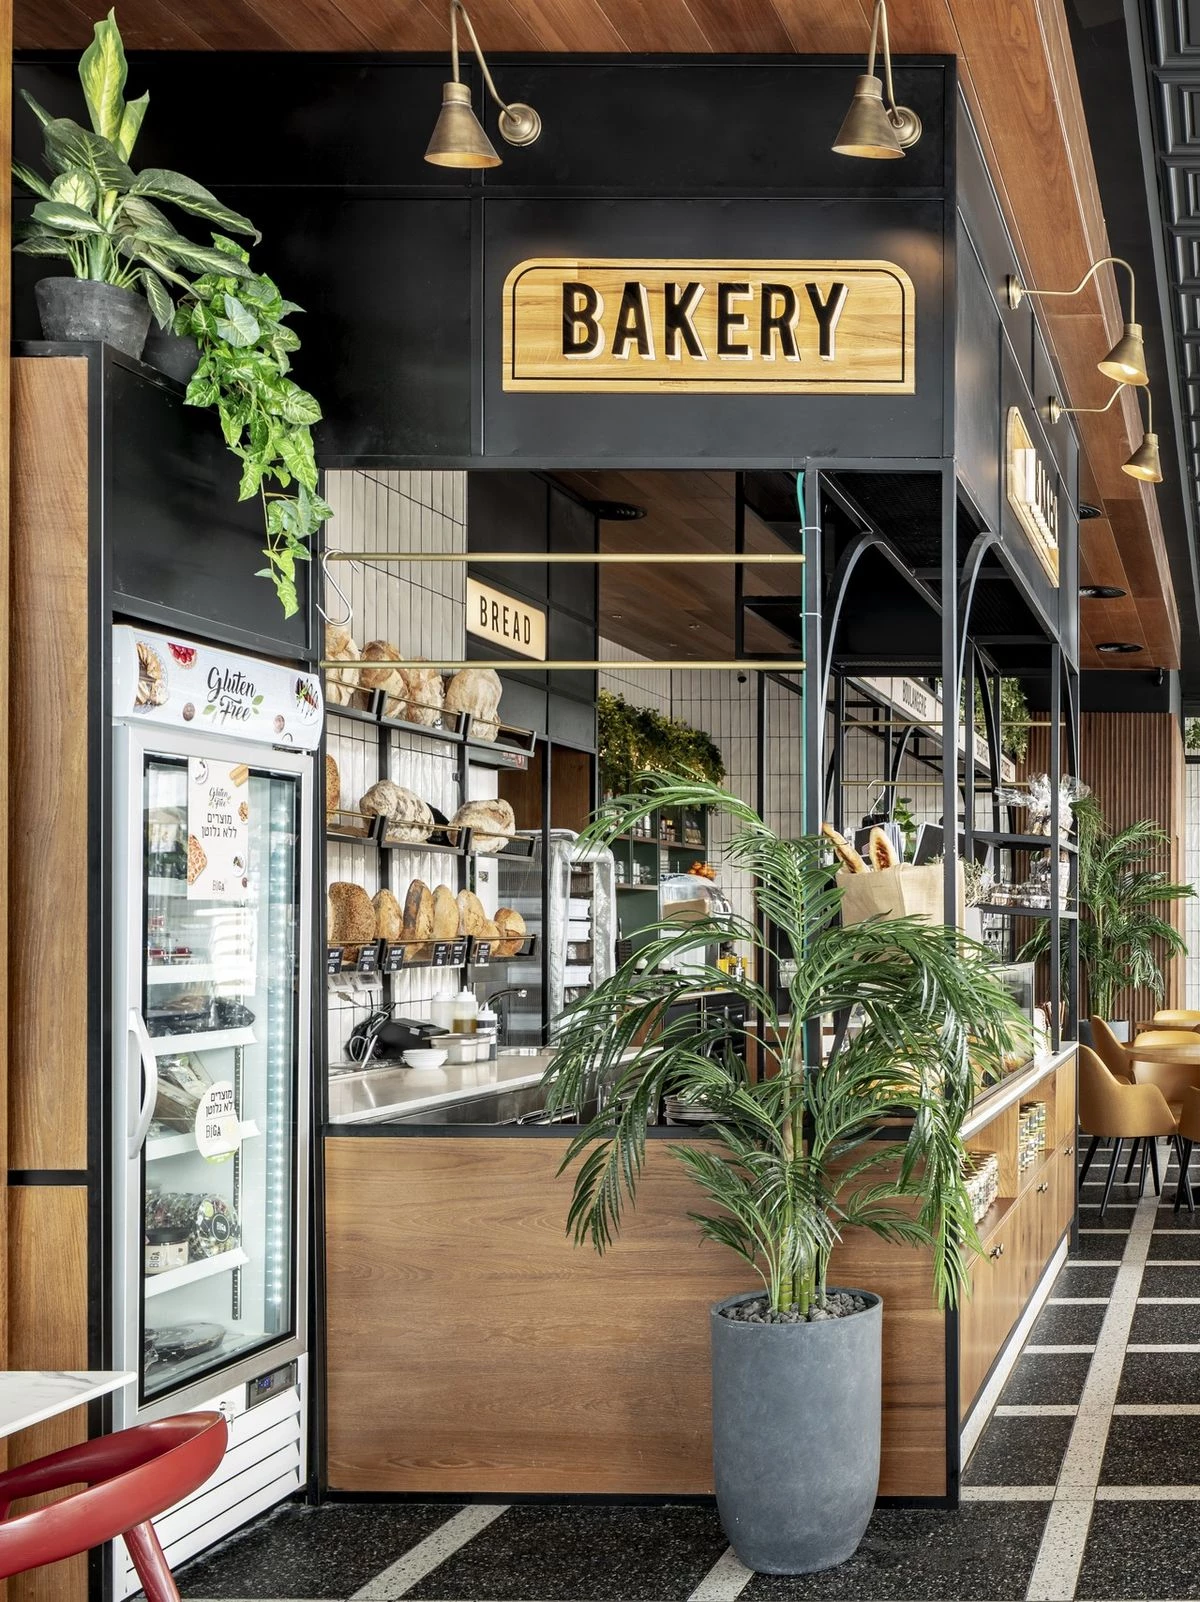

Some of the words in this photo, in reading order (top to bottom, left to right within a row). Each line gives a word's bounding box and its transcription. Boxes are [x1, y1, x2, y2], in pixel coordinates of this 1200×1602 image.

[561, 281, 850, 361] BAKERY
[480, 595, 531, 646] BREAD
[207, 666, 257, 703] Gluten
[219, 695, 251, 725] Free
[207, 813, 232, 825] מוצרים
[201, 825, 221, 839] גלוטן
[222, 826, 237, 839] ללא
[210, 1089, 233, 1102] מוצרים
[205, 1103, 222, 1117] גלוטן
